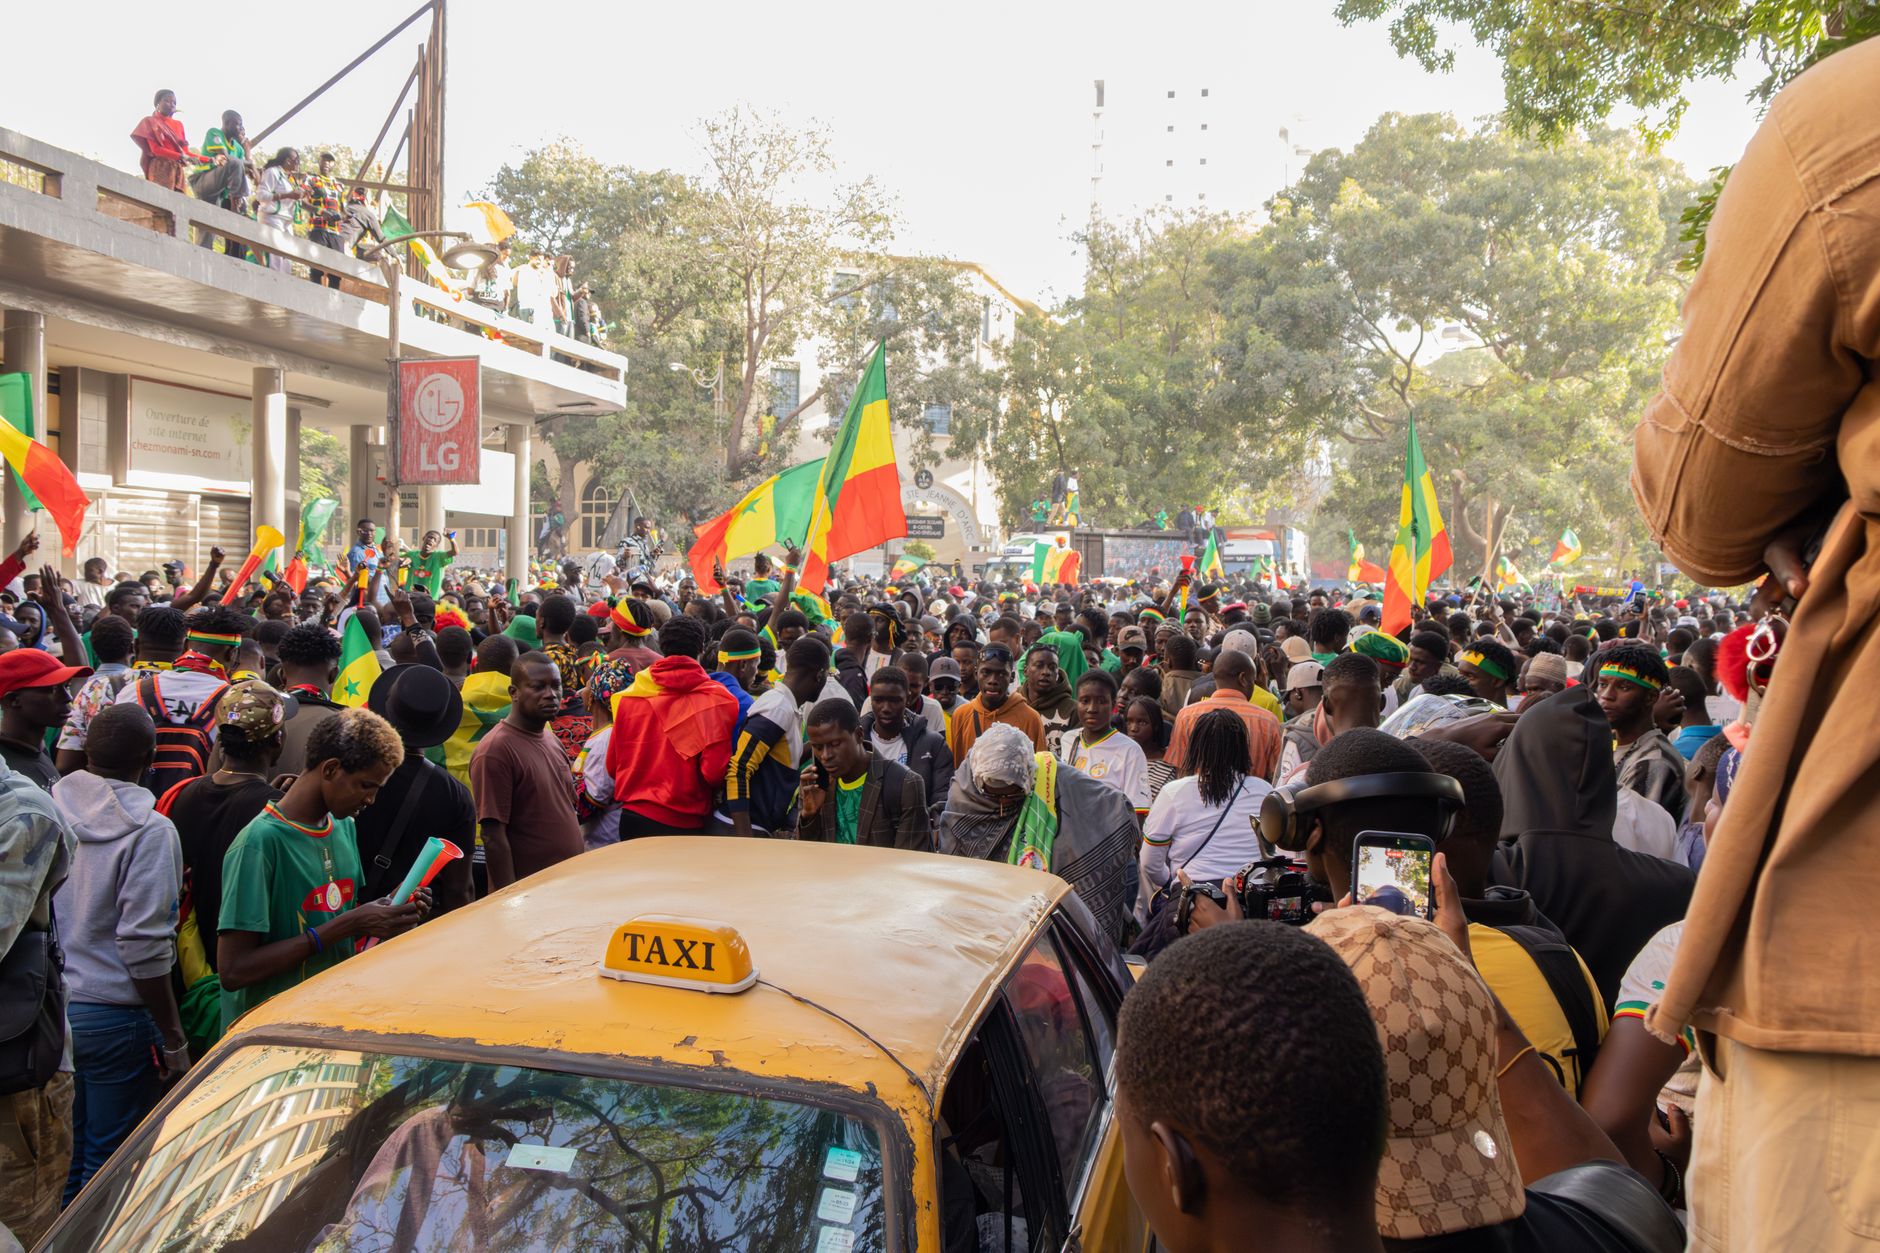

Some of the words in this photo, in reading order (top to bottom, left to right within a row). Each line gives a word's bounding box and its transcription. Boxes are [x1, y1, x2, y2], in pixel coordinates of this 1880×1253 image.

[145, 408, 197, 426] Ouverture
[148, 426, 166, 437] site
[168, 428, 208, 443] internet
[132, 439, 221, 460] chezmonami-sn.com
[420, 441, 460, 471] LG
[906, 490, 919, 499] STE
[926, 490, 957, 509] JEANNE
[957, 510, 974, 539] D'ARC
[623, 933, 715, 972] TAXI
